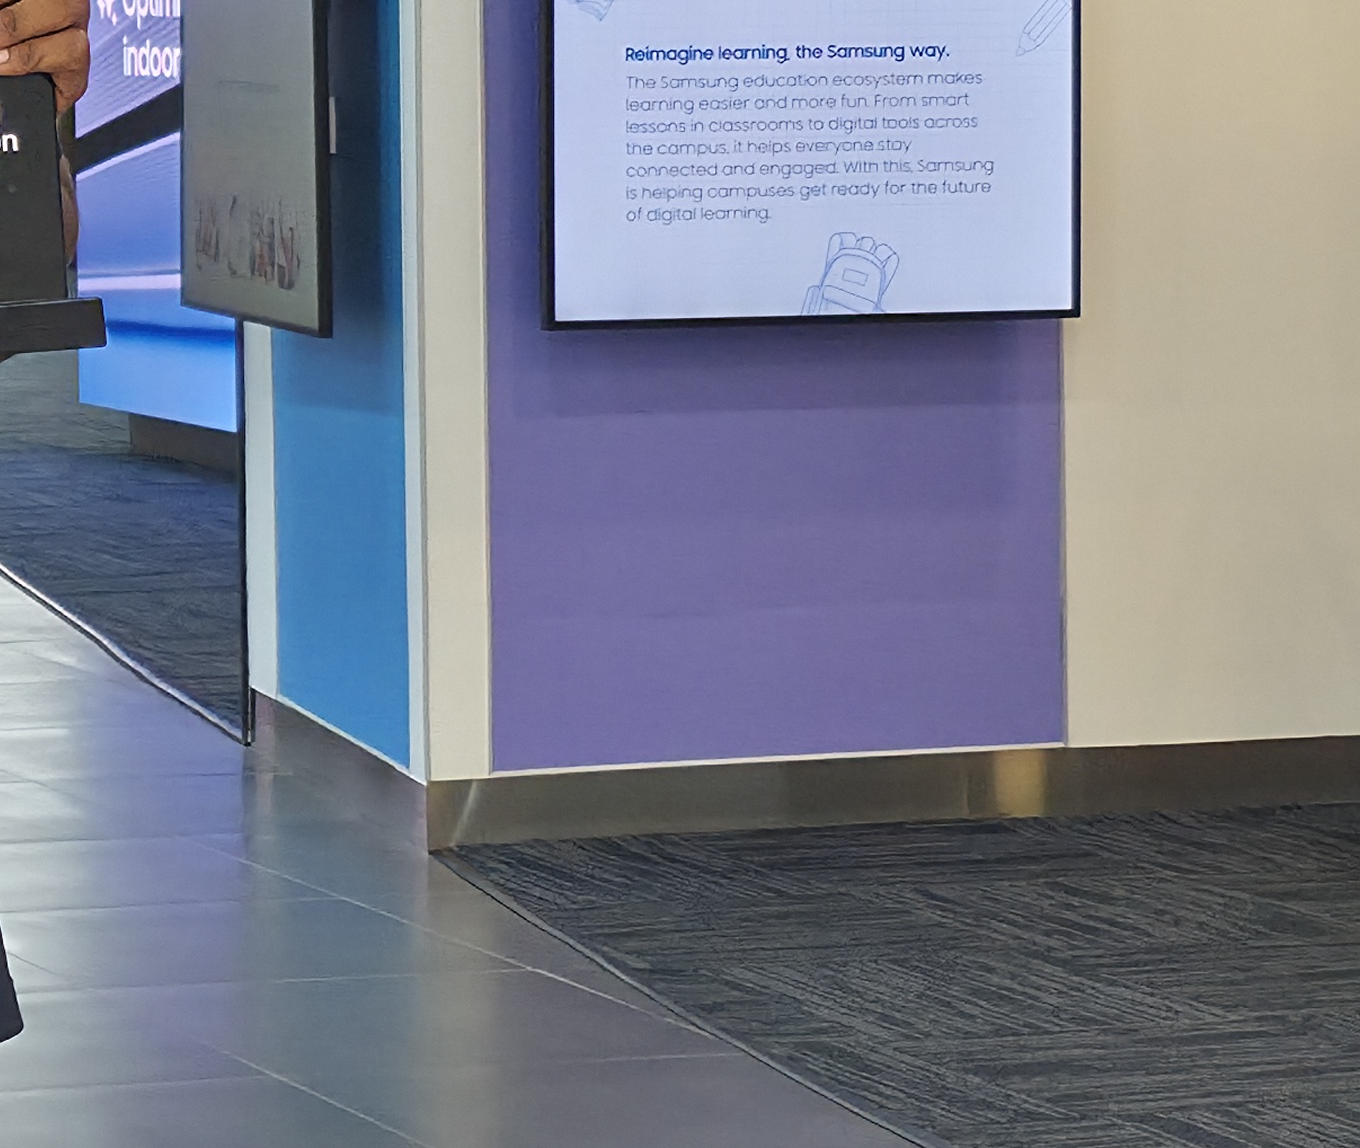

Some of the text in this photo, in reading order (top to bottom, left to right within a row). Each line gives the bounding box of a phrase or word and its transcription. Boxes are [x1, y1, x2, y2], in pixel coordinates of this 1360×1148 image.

[625, 45, 714, 65] Reimagine
[795, 44, 823, 59] the
[827, 44, 905, 62] Samsung
[909, 45, 950, 61] way.
[626, 72, 983, 92] The Samsung education ecosystem makes
[625, 98, 695, 115] learning
[698, 96, 749, 111] easier
[754, 95, 787, 109] and
[791, 97, 837, 109] more
[873, 94, 917, 108] From
[921, 93, 970, 107] smart
[625, 116, 978, 135] lessons in classrooms to digital tools across
[626, 142, 653, 155] the
[733, 140, 743, 153] it
[747, 140, 792, 156] helps
[795, 140, 874, 156] everyone
[877, 139, 912, 154] stay
[626, 162, 718, 177] connected
[722, 162, 755, 176] and
[759, 160, 840, 179] engaged.
[843, 160, 879, 173] With
[917, 159, 995, 176] Samsung
[626, 180, 992, 202] is helping campuses get ready for the future
[626, 206, 772, 225] of digital learning.
